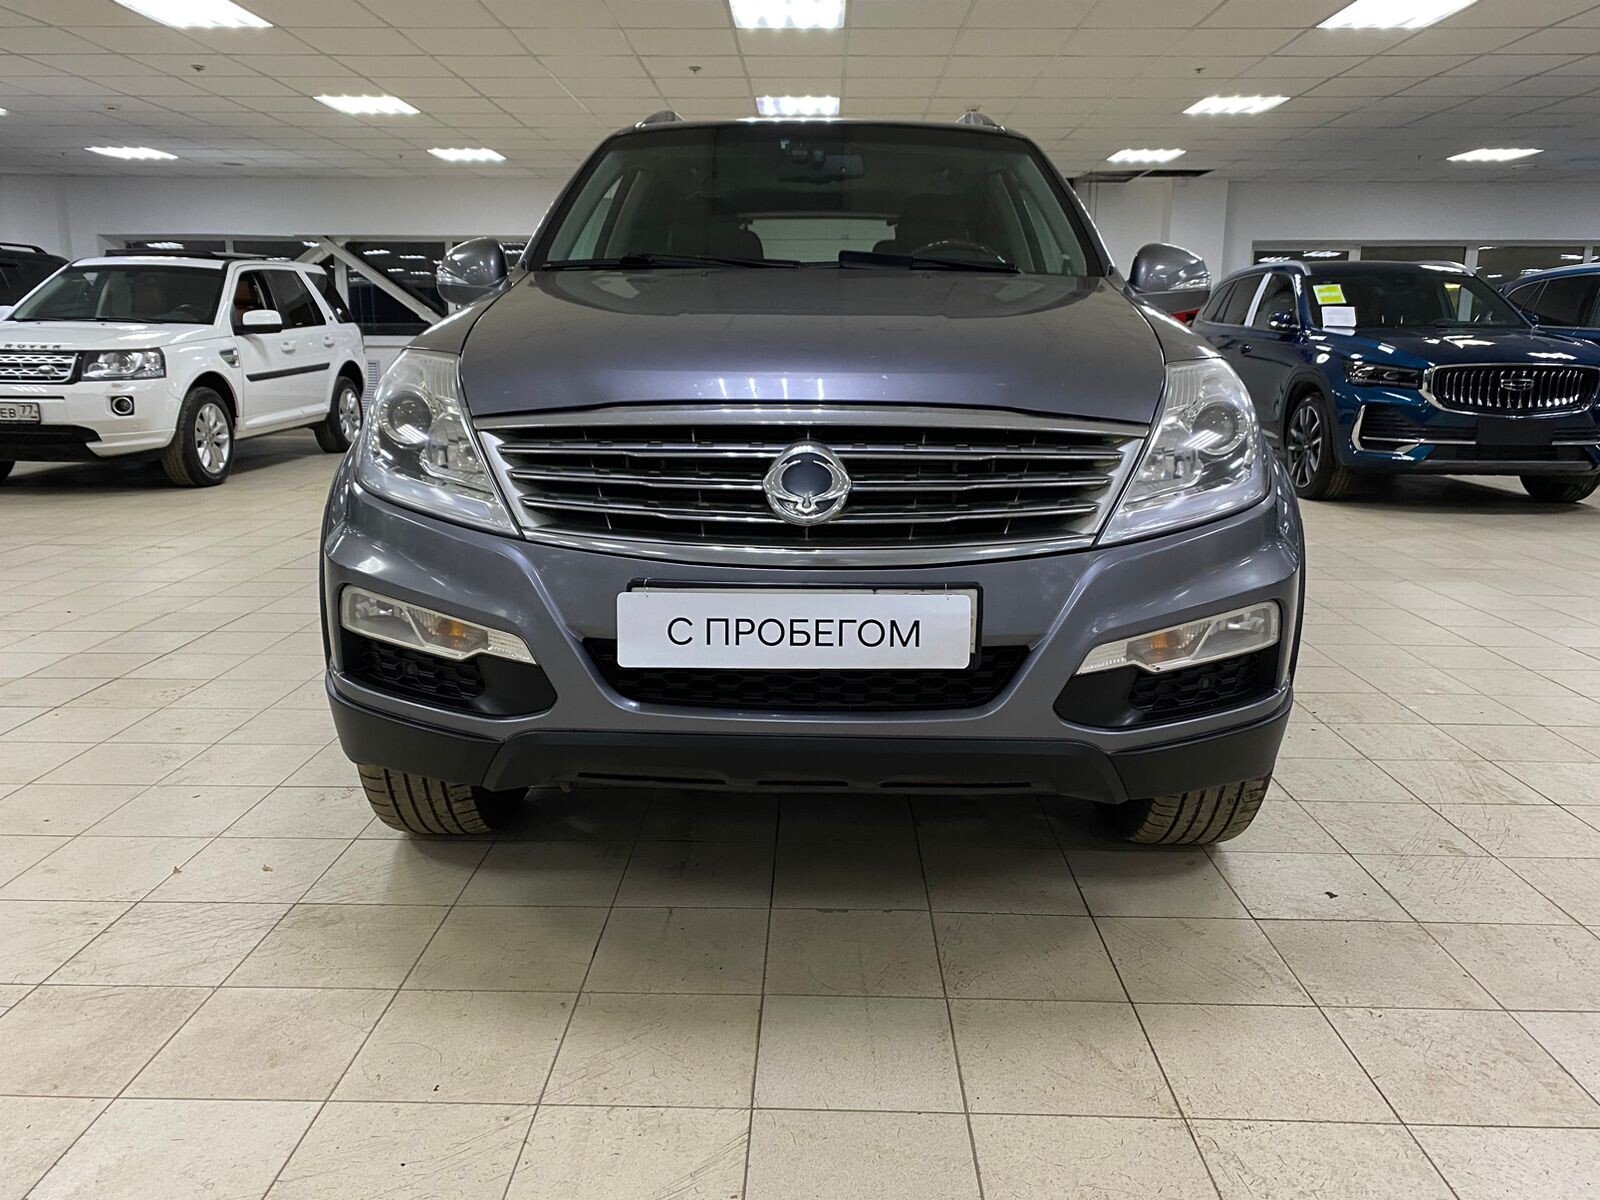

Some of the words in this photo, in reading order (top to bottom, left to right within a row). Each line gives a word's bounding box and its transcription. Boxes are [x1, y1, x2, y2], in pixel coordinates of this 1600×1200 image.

[19, 404, 33, 415] 77
[667, 617, 693, 646] С
[706, 617, 921, 648] ПРОБЕГОМ
